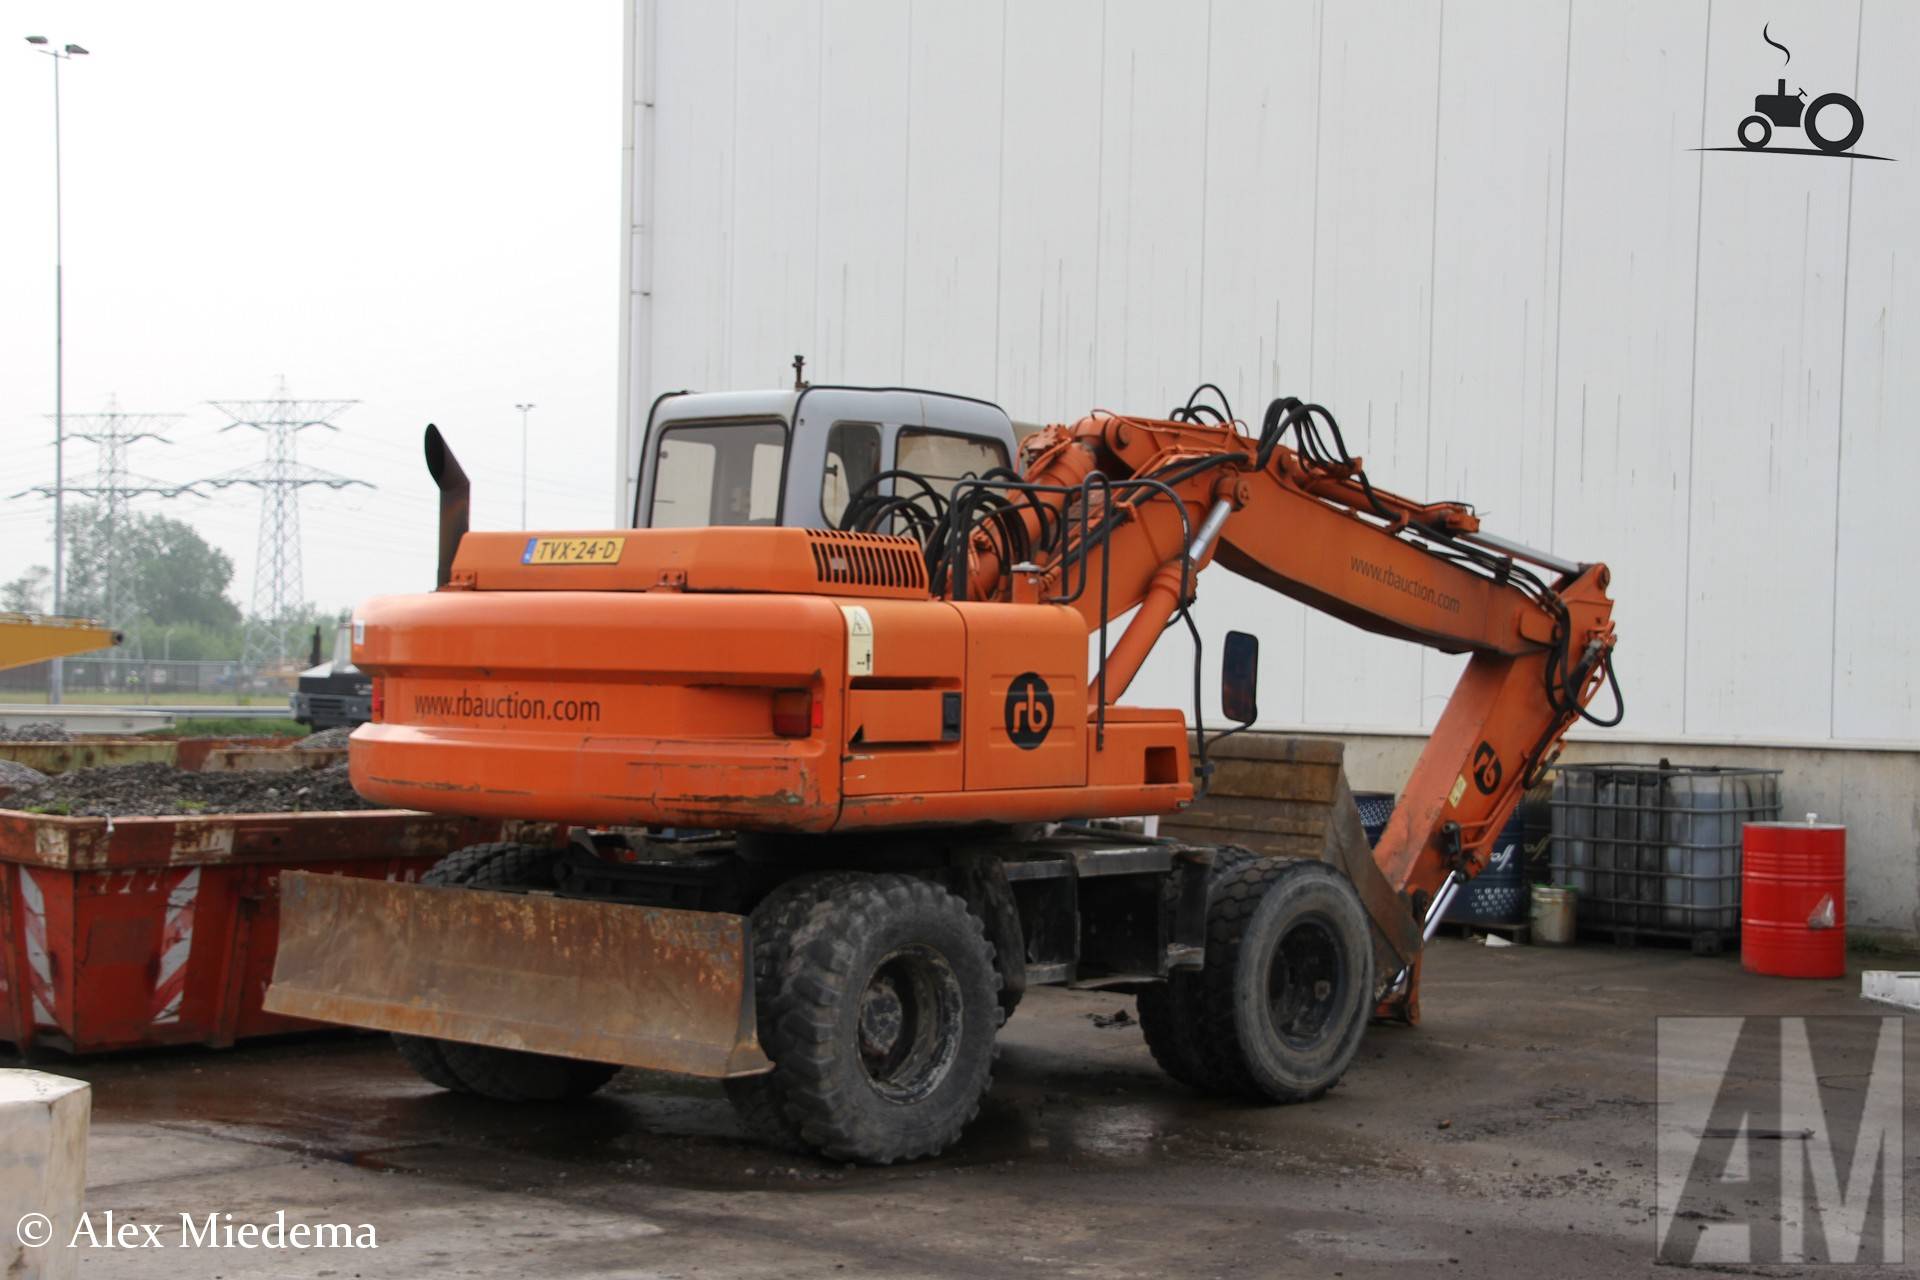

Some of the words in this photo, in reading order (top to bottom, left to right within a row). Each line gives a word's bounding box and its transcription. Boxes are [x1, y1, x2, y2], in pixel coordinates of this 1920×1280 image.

[540, 540, 616, 560] TVX-24-D
[1350, 555, 1461, 614] www.rbauction.com
[414, 688, 601, 721] www.rbauction.com
